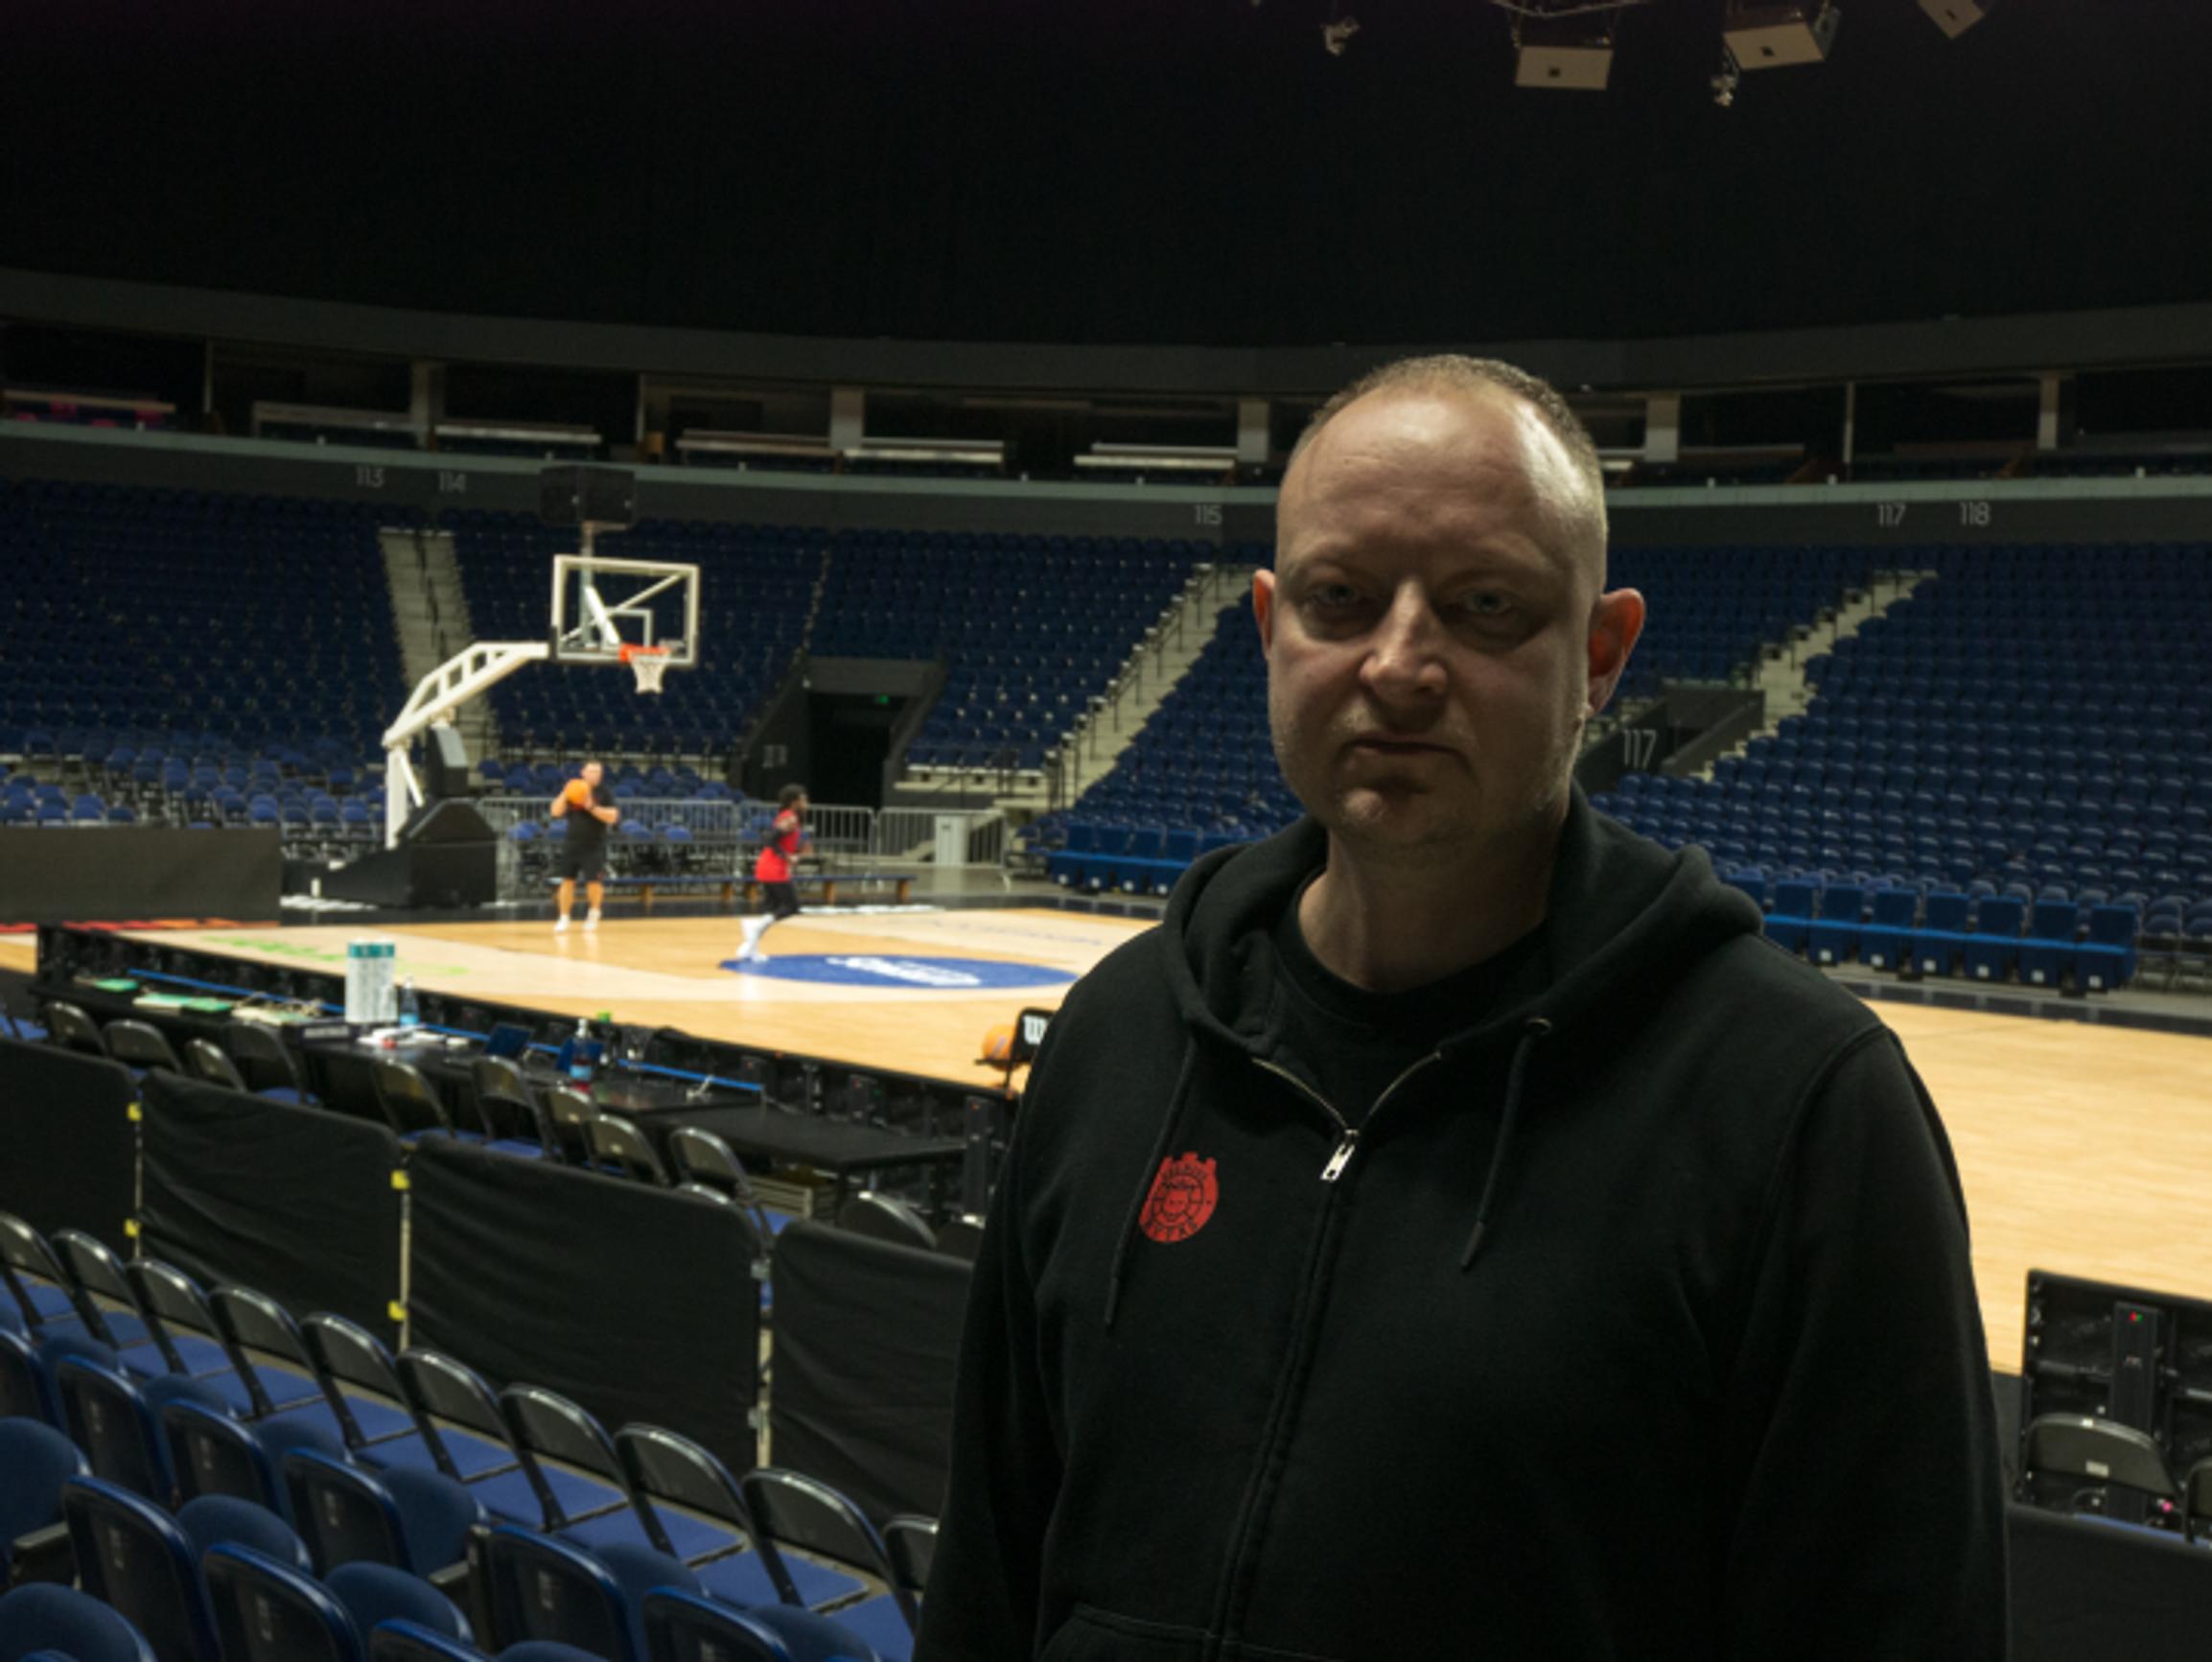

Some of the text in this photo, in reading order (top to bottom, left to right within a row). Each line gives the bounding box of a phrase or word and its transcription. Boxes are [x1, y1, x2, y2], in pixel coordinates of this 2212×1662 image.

[1876, 503, 1907, 527] 117
[1960, 502, 1991, 527] 118
[1622, 729, 1658, 769] 117
